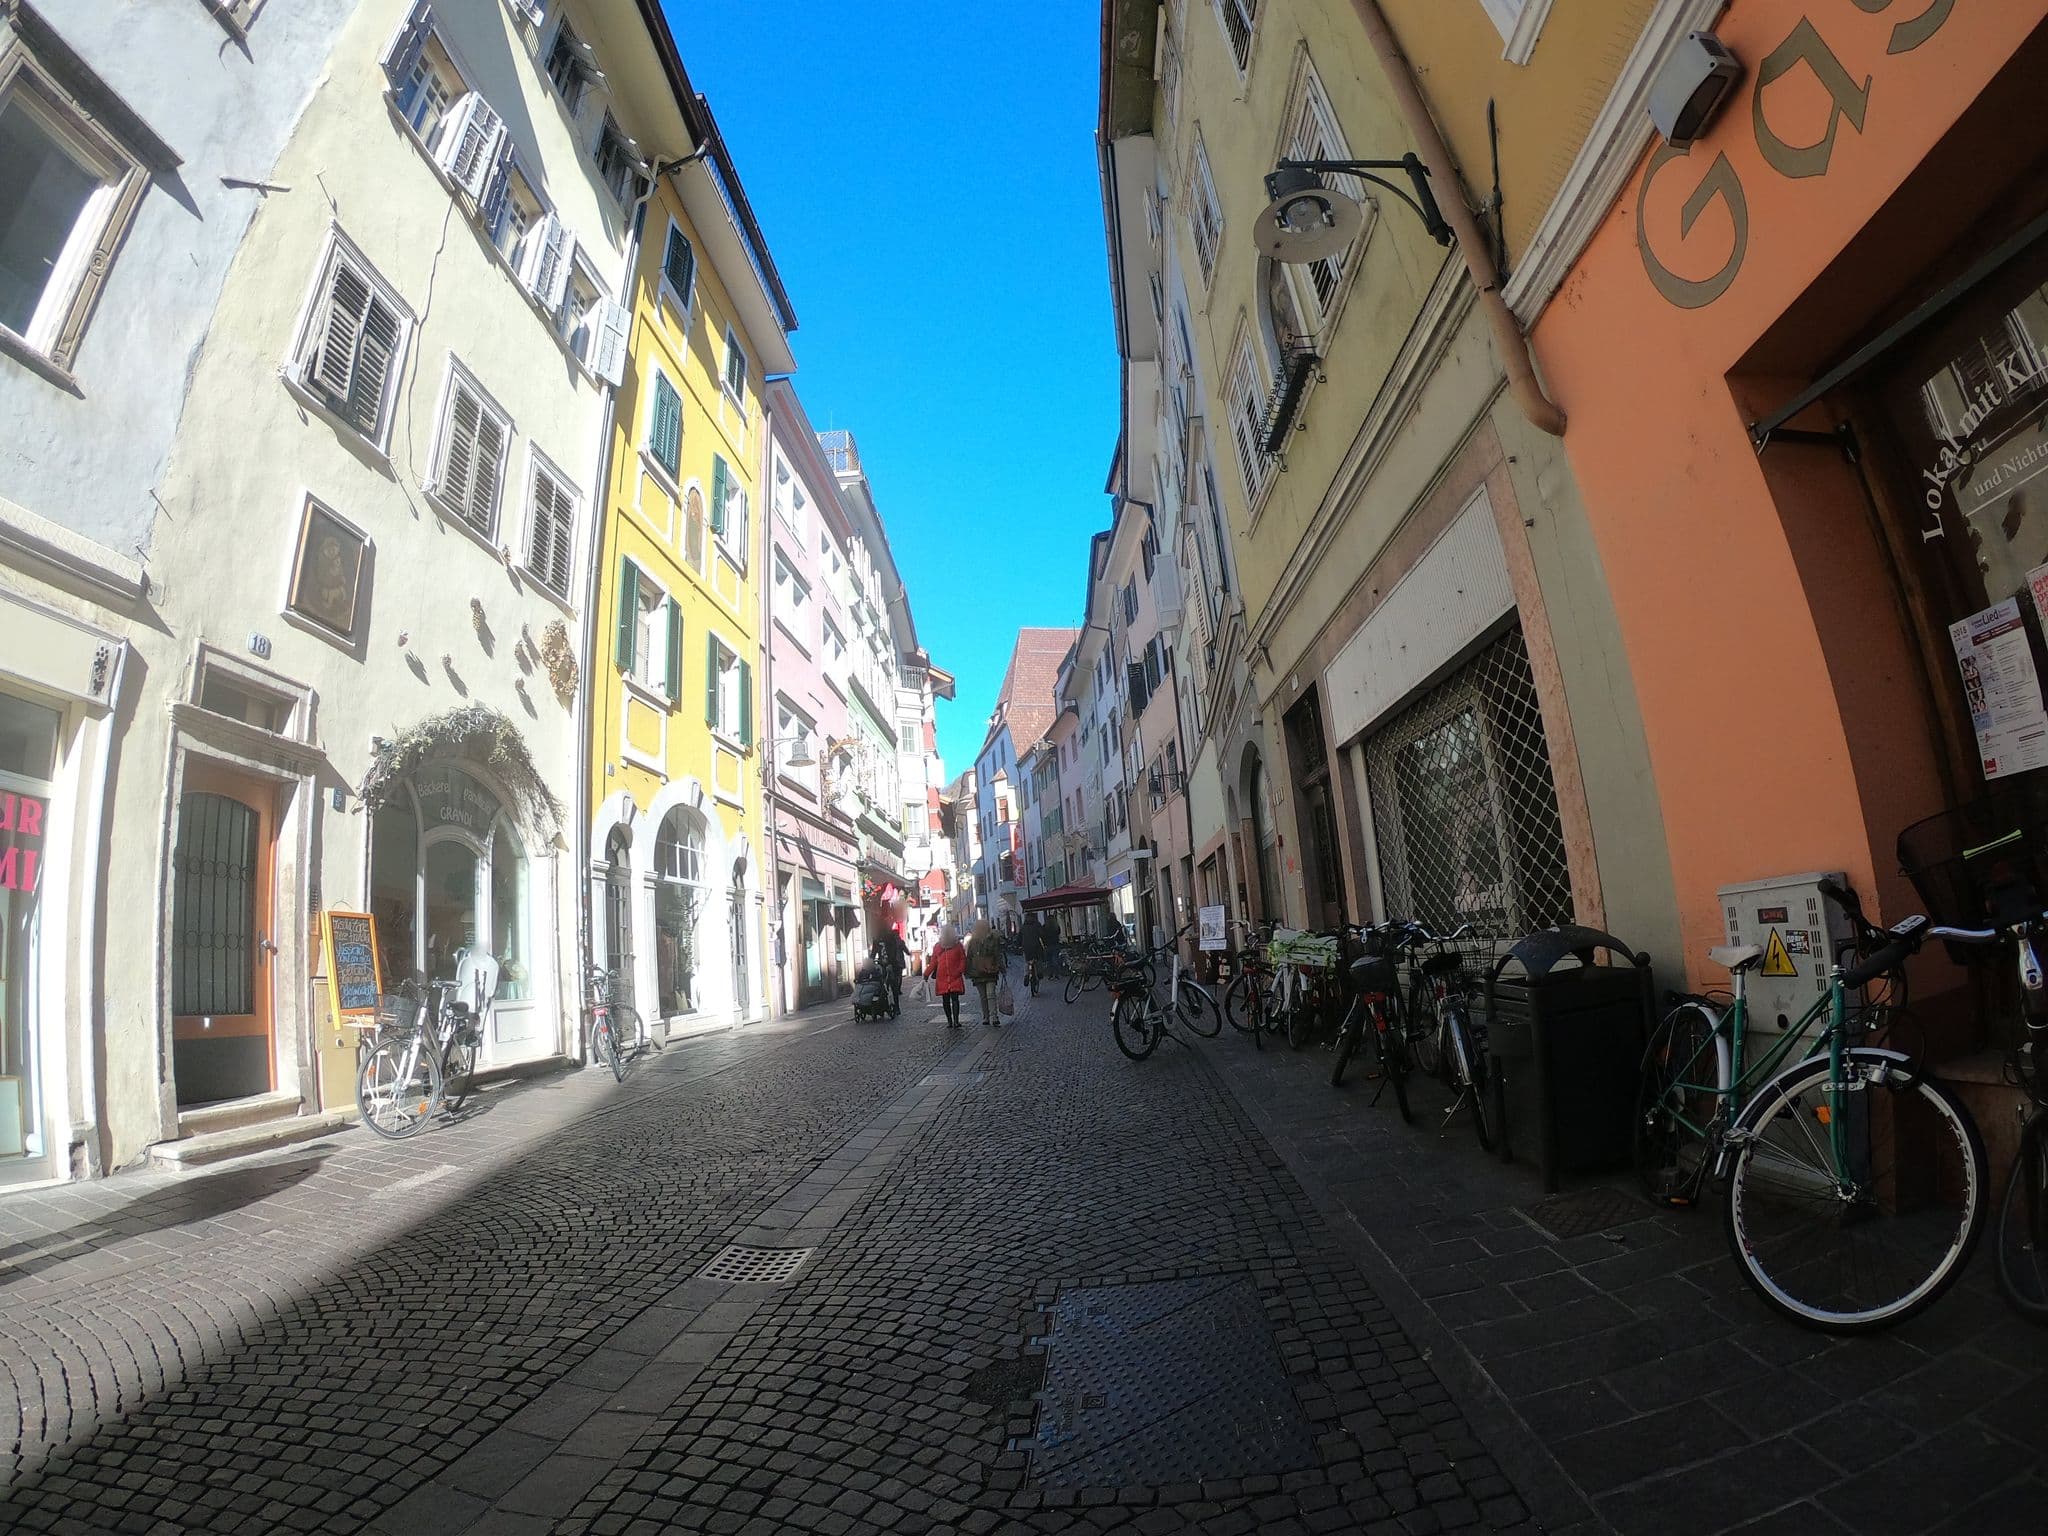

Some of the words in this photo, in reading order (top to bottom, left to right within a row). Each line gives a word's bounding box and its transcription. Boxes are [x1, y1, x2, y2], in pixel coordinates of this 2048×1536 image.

[1921, 427, 1963, 544] Lokal
[1958, 380, 2002, 438] mit
[1974, 468, 2003, 497] und
[251, 635, 267, 654] 18
[440, 806, 473, 827] GRANDI
